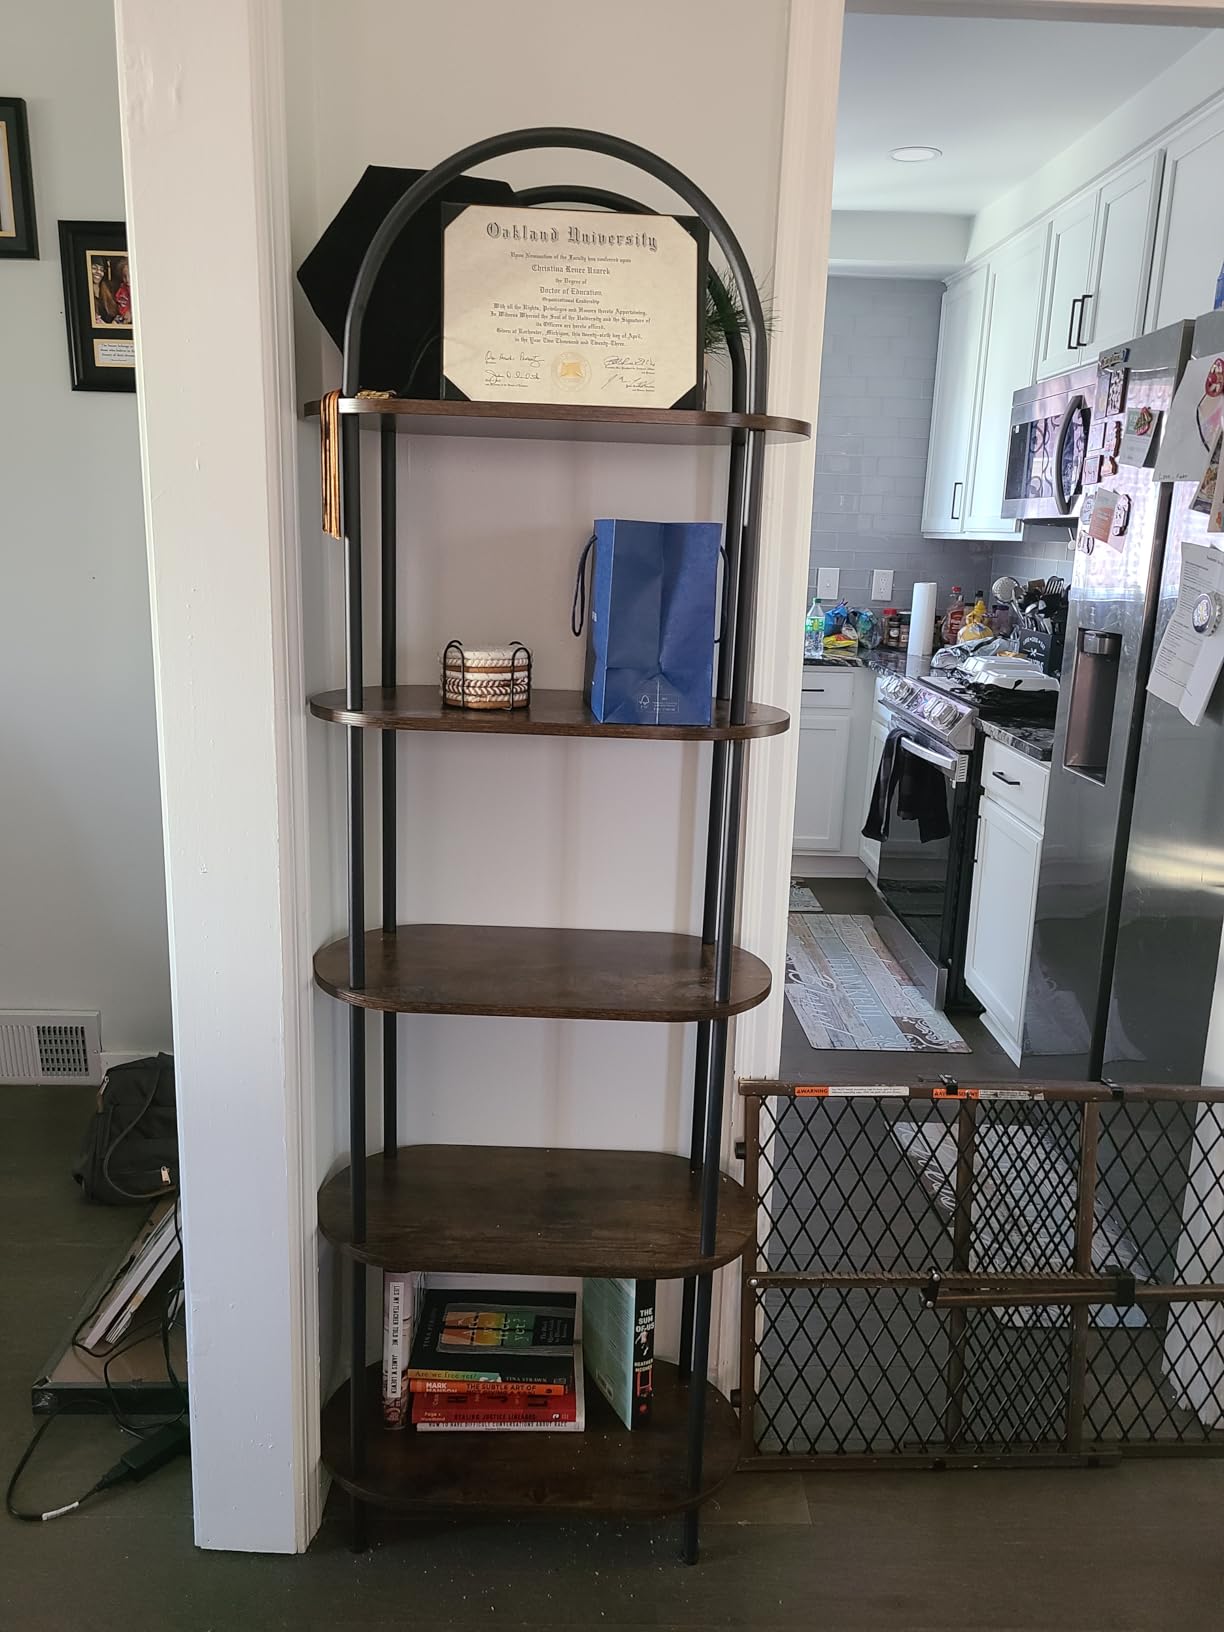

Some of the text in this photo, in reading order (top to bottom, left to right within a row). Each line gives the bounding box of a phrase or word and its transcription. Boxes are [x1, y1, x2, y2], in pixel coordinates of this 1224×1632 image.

[486, 222, 658, 252] Oakland University
[532, 264, 564, 272] Christina
[826, 957, 884, 1017] THANKFUL
[640, 1308, 653, 1317] THE
[638, 1316, 654, 1324] SUM
[636, 1322, 655, 1332] OF US
[634, 1358, 654, 1367] HEATHER
